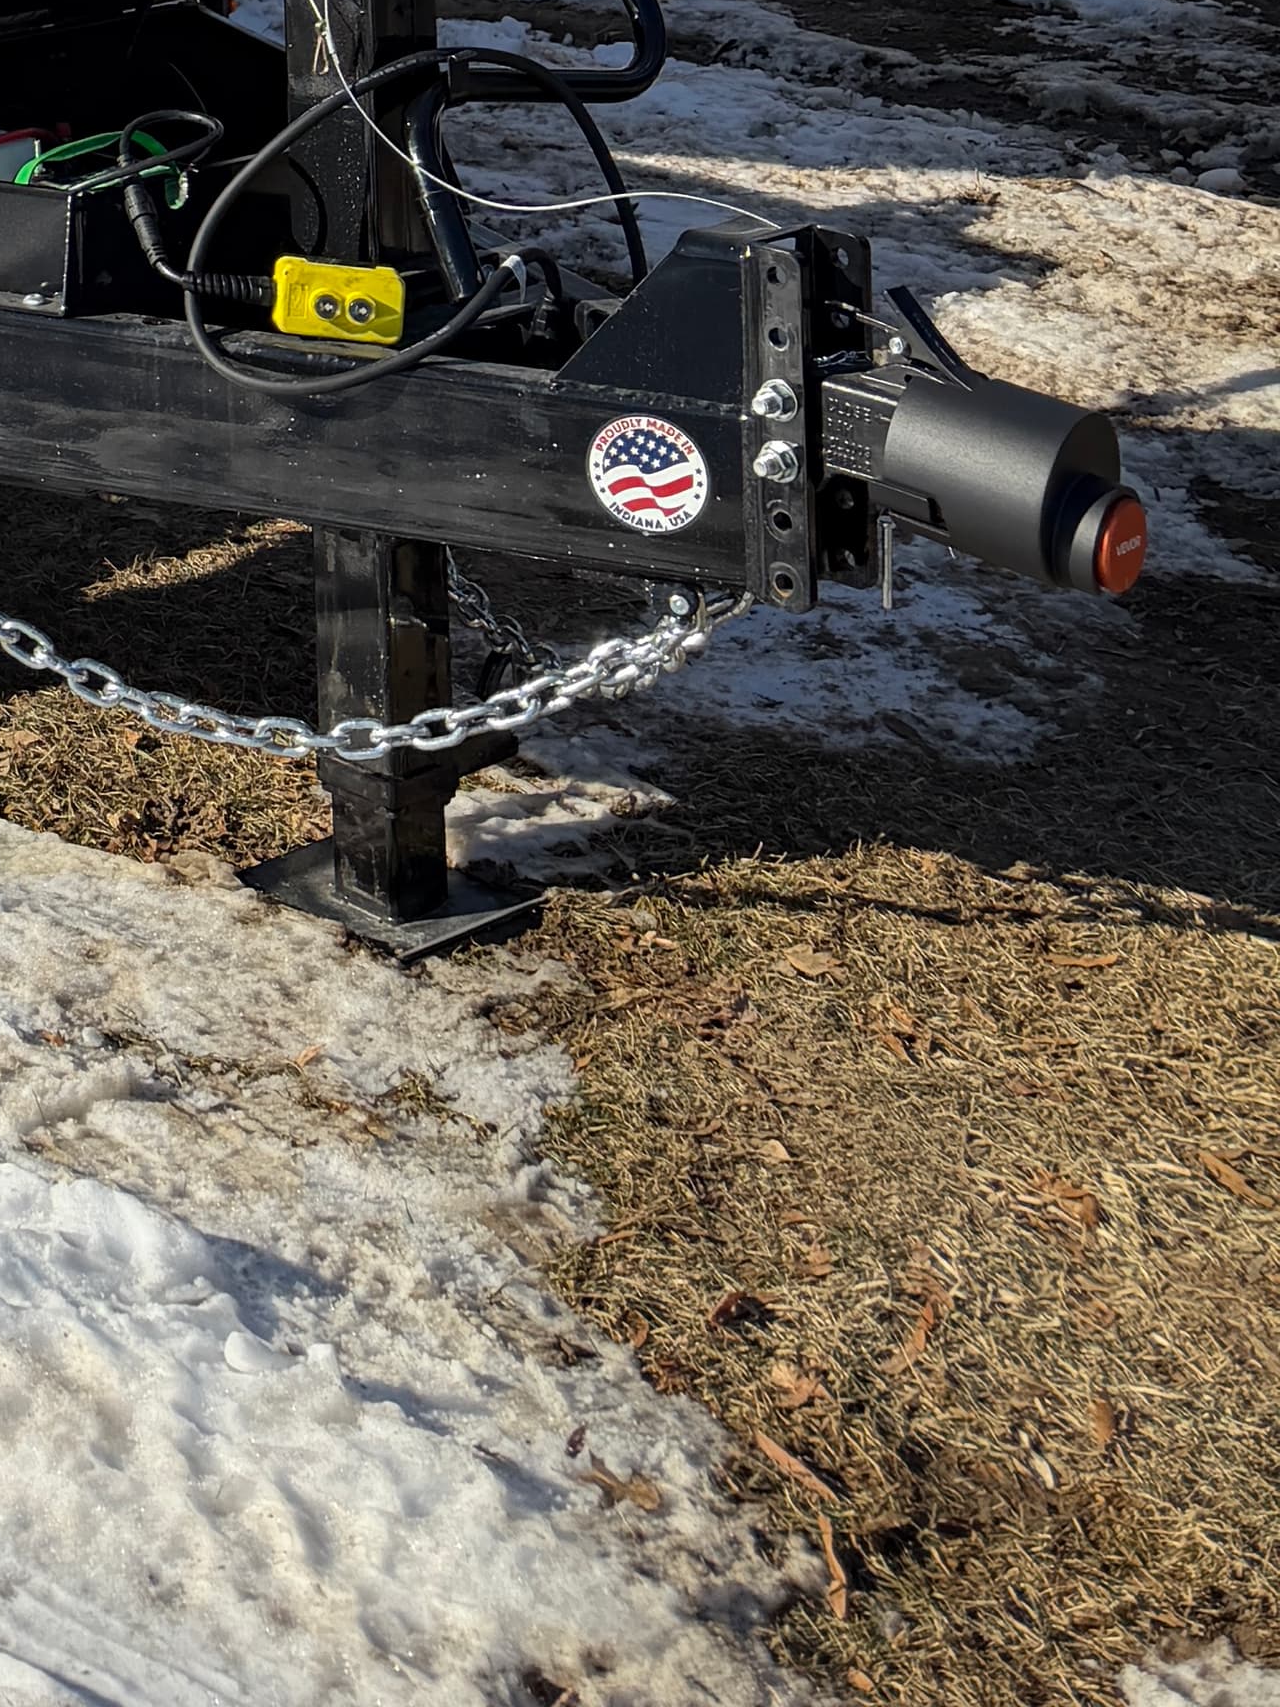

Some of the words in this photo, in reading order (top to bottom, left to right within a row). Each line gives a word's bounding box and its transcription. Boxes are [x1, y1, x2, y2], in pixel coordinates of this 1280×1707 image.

[595, 418, 642, 452] PROUDLY
[646, 419, 682, 442] MADE
[681, 440, 695, 455] IN
[609, 501, 668, 531] INDIANA,
[669, 510, 693, 527] USA
